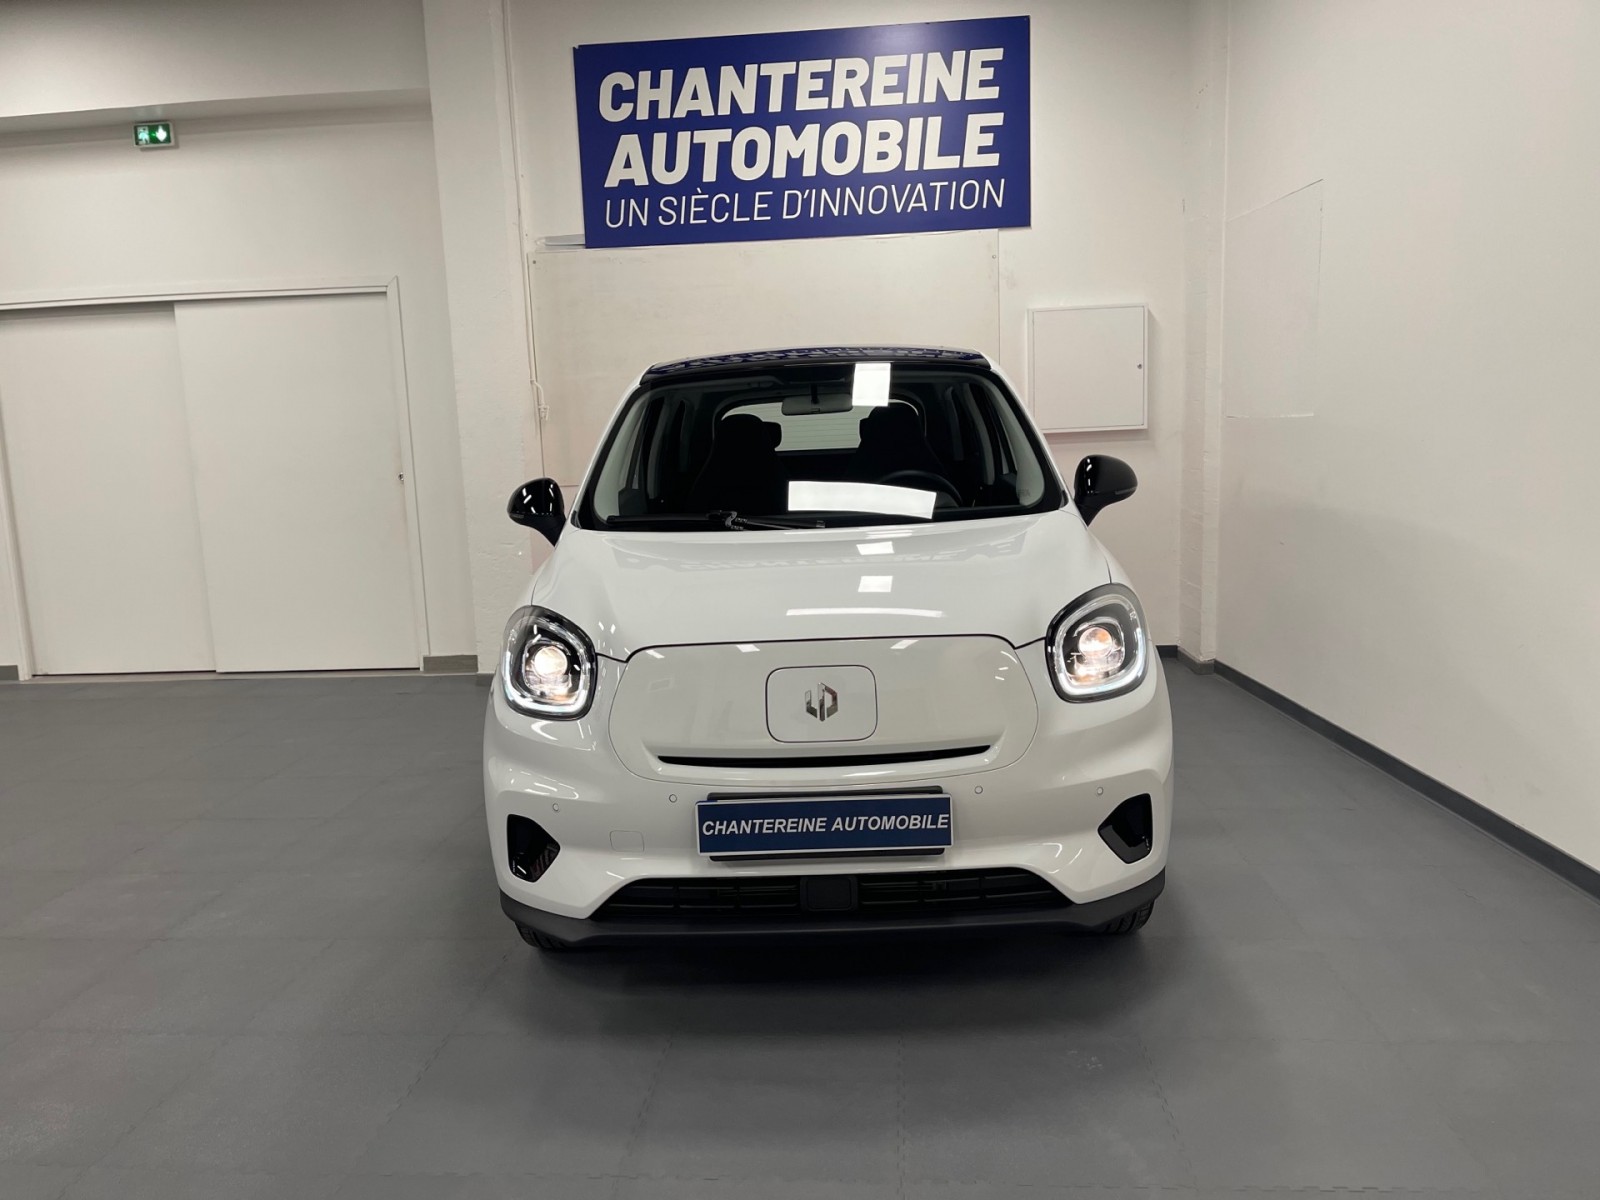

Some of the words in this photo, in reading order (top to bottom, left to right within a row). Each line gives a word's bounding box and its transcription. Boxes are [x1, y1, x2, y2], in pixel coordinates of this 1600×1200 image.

[599, 48, 1004, 122] CHANTEREINE
[604, 113, 1005, 188] AUTOMOBILE
[605, 198, 649, 228] UN
[658, 187, 774, 227] SIÈCLE
[782, 178, 1005, 220] D'INNOVATION
[702, 817, 827, 836] CHANTEREINE
[831, 813, 950, 832] AUTOMOBILE
